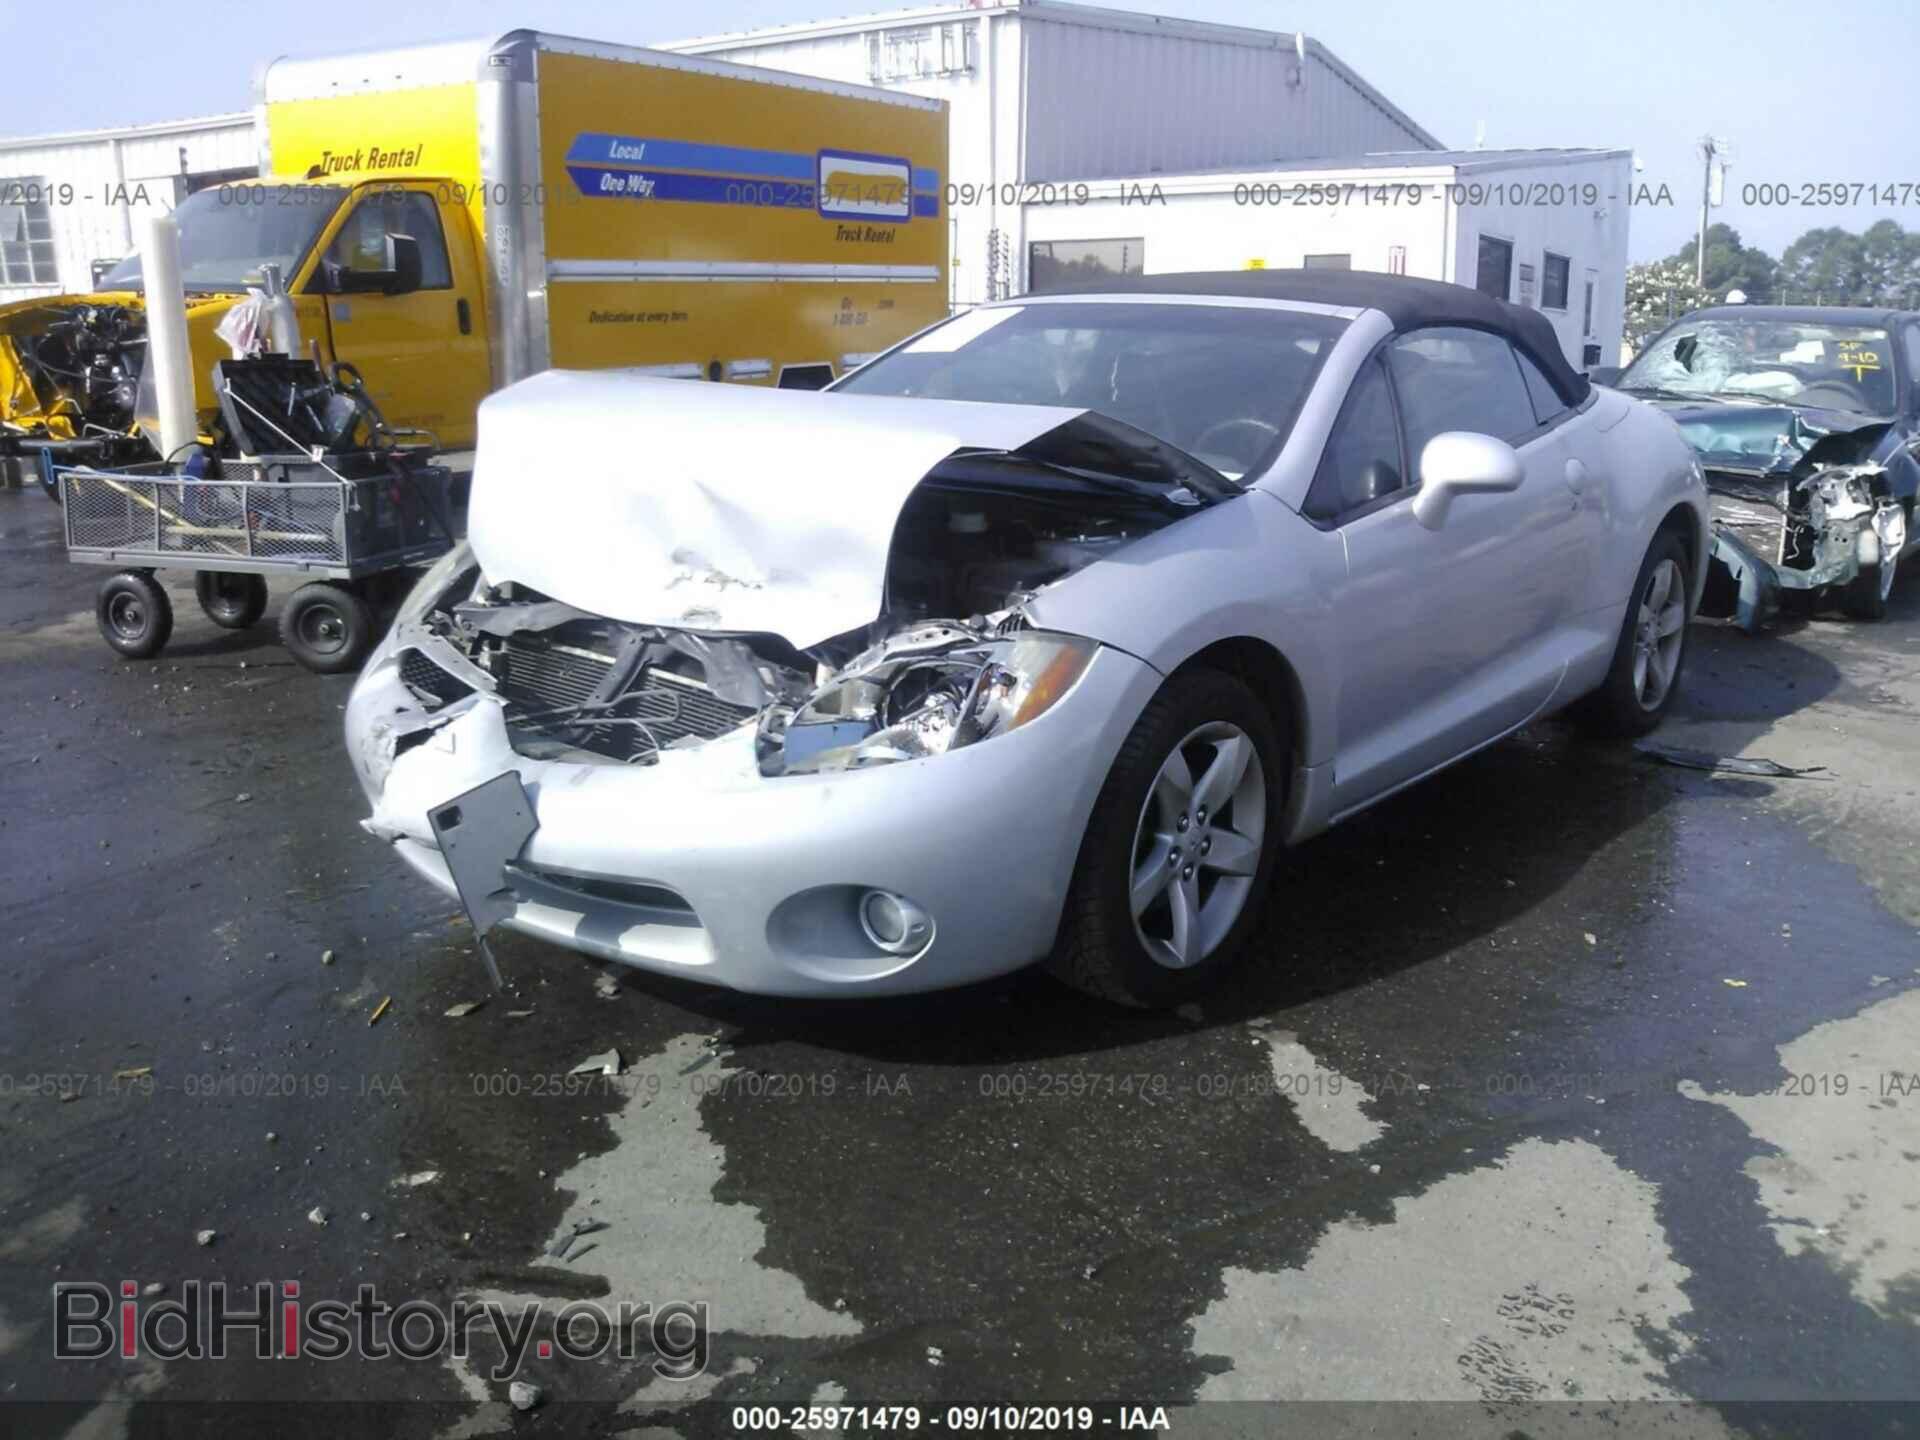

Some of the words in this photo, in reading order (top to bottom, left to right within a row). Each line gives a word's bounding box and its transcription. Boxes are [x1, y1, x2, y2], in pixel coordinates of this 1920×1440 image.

[321, 148, 364, 174] Truck
[366, 143, 424, 170] Rental
[609, 140, 646, 161] Local
[600, 173, 625, 192] One
[628, 174, 656, 197] Way
